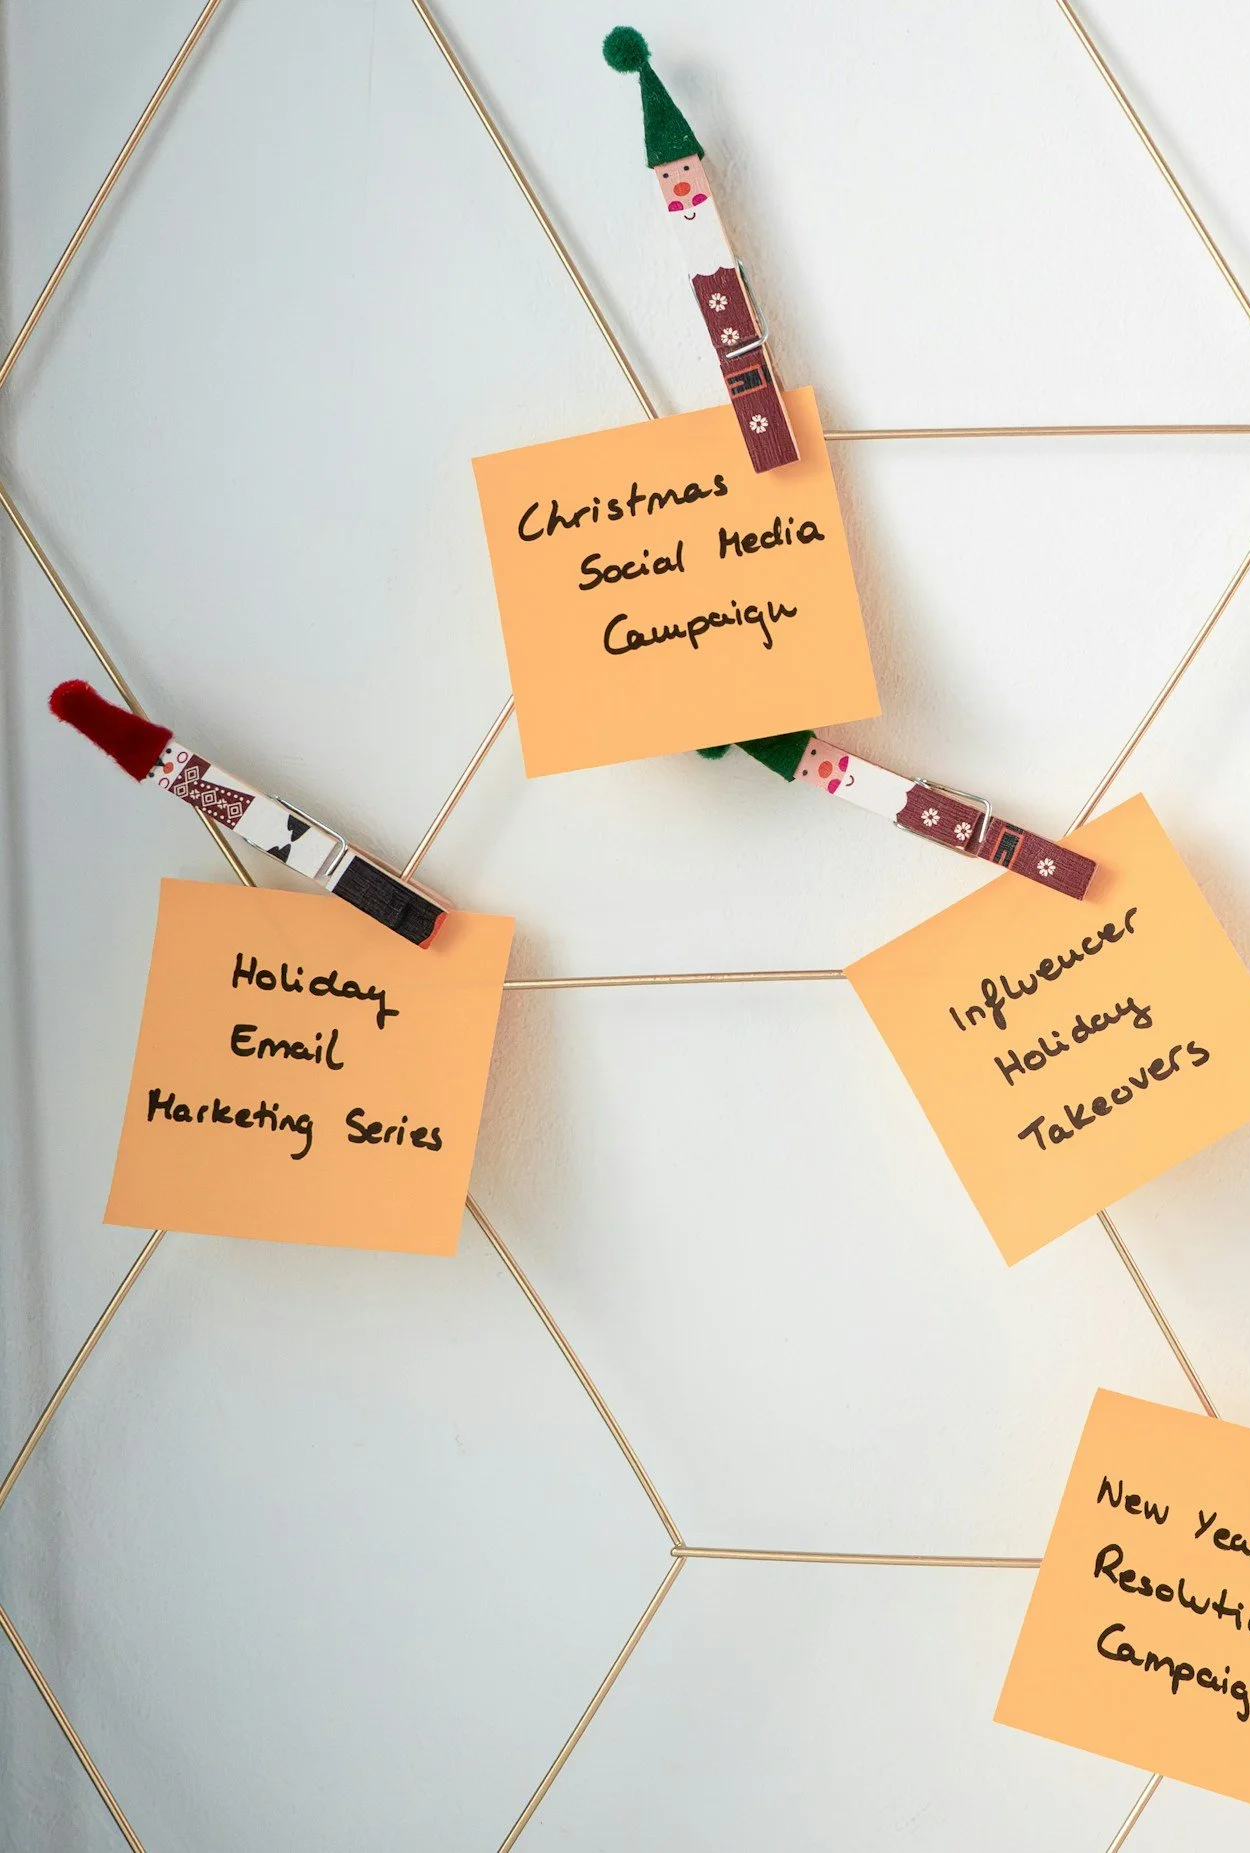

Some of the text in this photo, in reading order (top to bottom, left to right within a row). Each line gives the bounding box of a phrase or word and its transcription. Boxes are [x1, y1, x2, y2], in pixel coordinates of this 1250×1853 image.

[517, 474, 728, 542] Christmas
[578, 516, 826, 591] Social Media
[603, 601, 798, 656] Campaign
[231, 952, 400, 1031] Holiday
[949, 907, 1138, 1032] Influencer
[230, 1023, 345, 1071] Email
[993, 997, 1153, 1087] Holiday
[147, 1087, 443, 1161] Marketing Series
[1017, 1040, 1210, 1151] Takeovers
[1096, 1475, 1170, 1525] New
